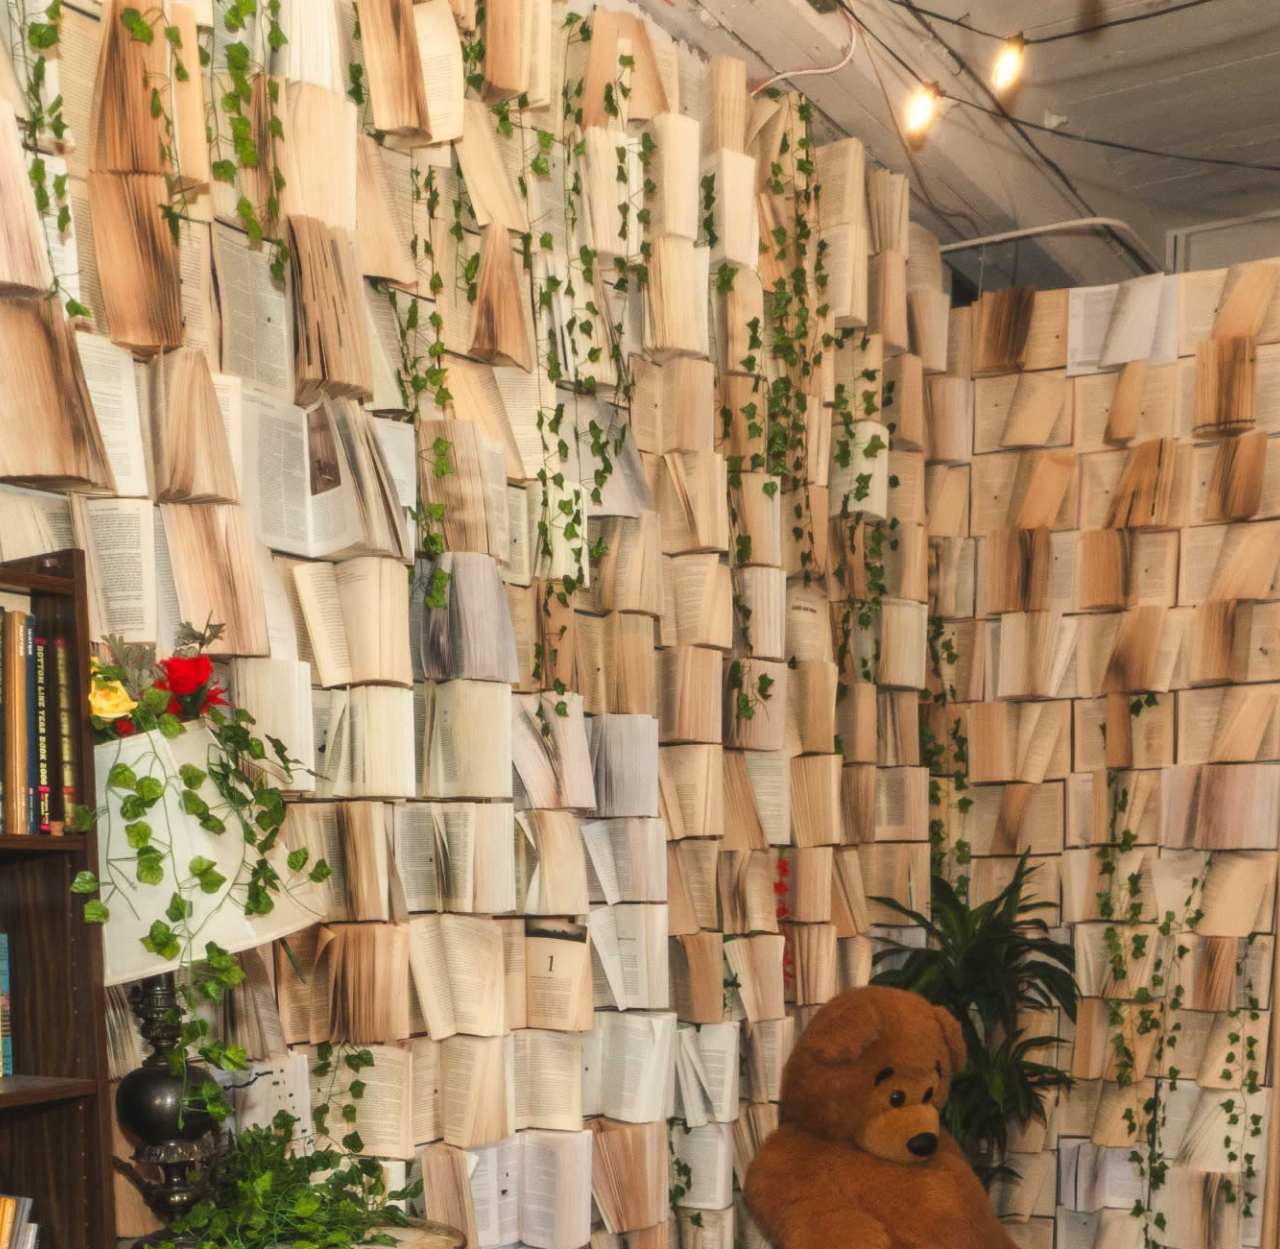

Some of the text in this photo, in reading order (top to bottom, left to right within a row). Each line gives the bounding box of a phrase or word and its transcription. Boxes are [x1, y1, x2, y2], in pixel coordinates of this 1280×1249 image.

[37, 645, 45, 684] BOTTOM
[39, 736, 47, 760] BOOK
[547, 955, 554, 972] 1
